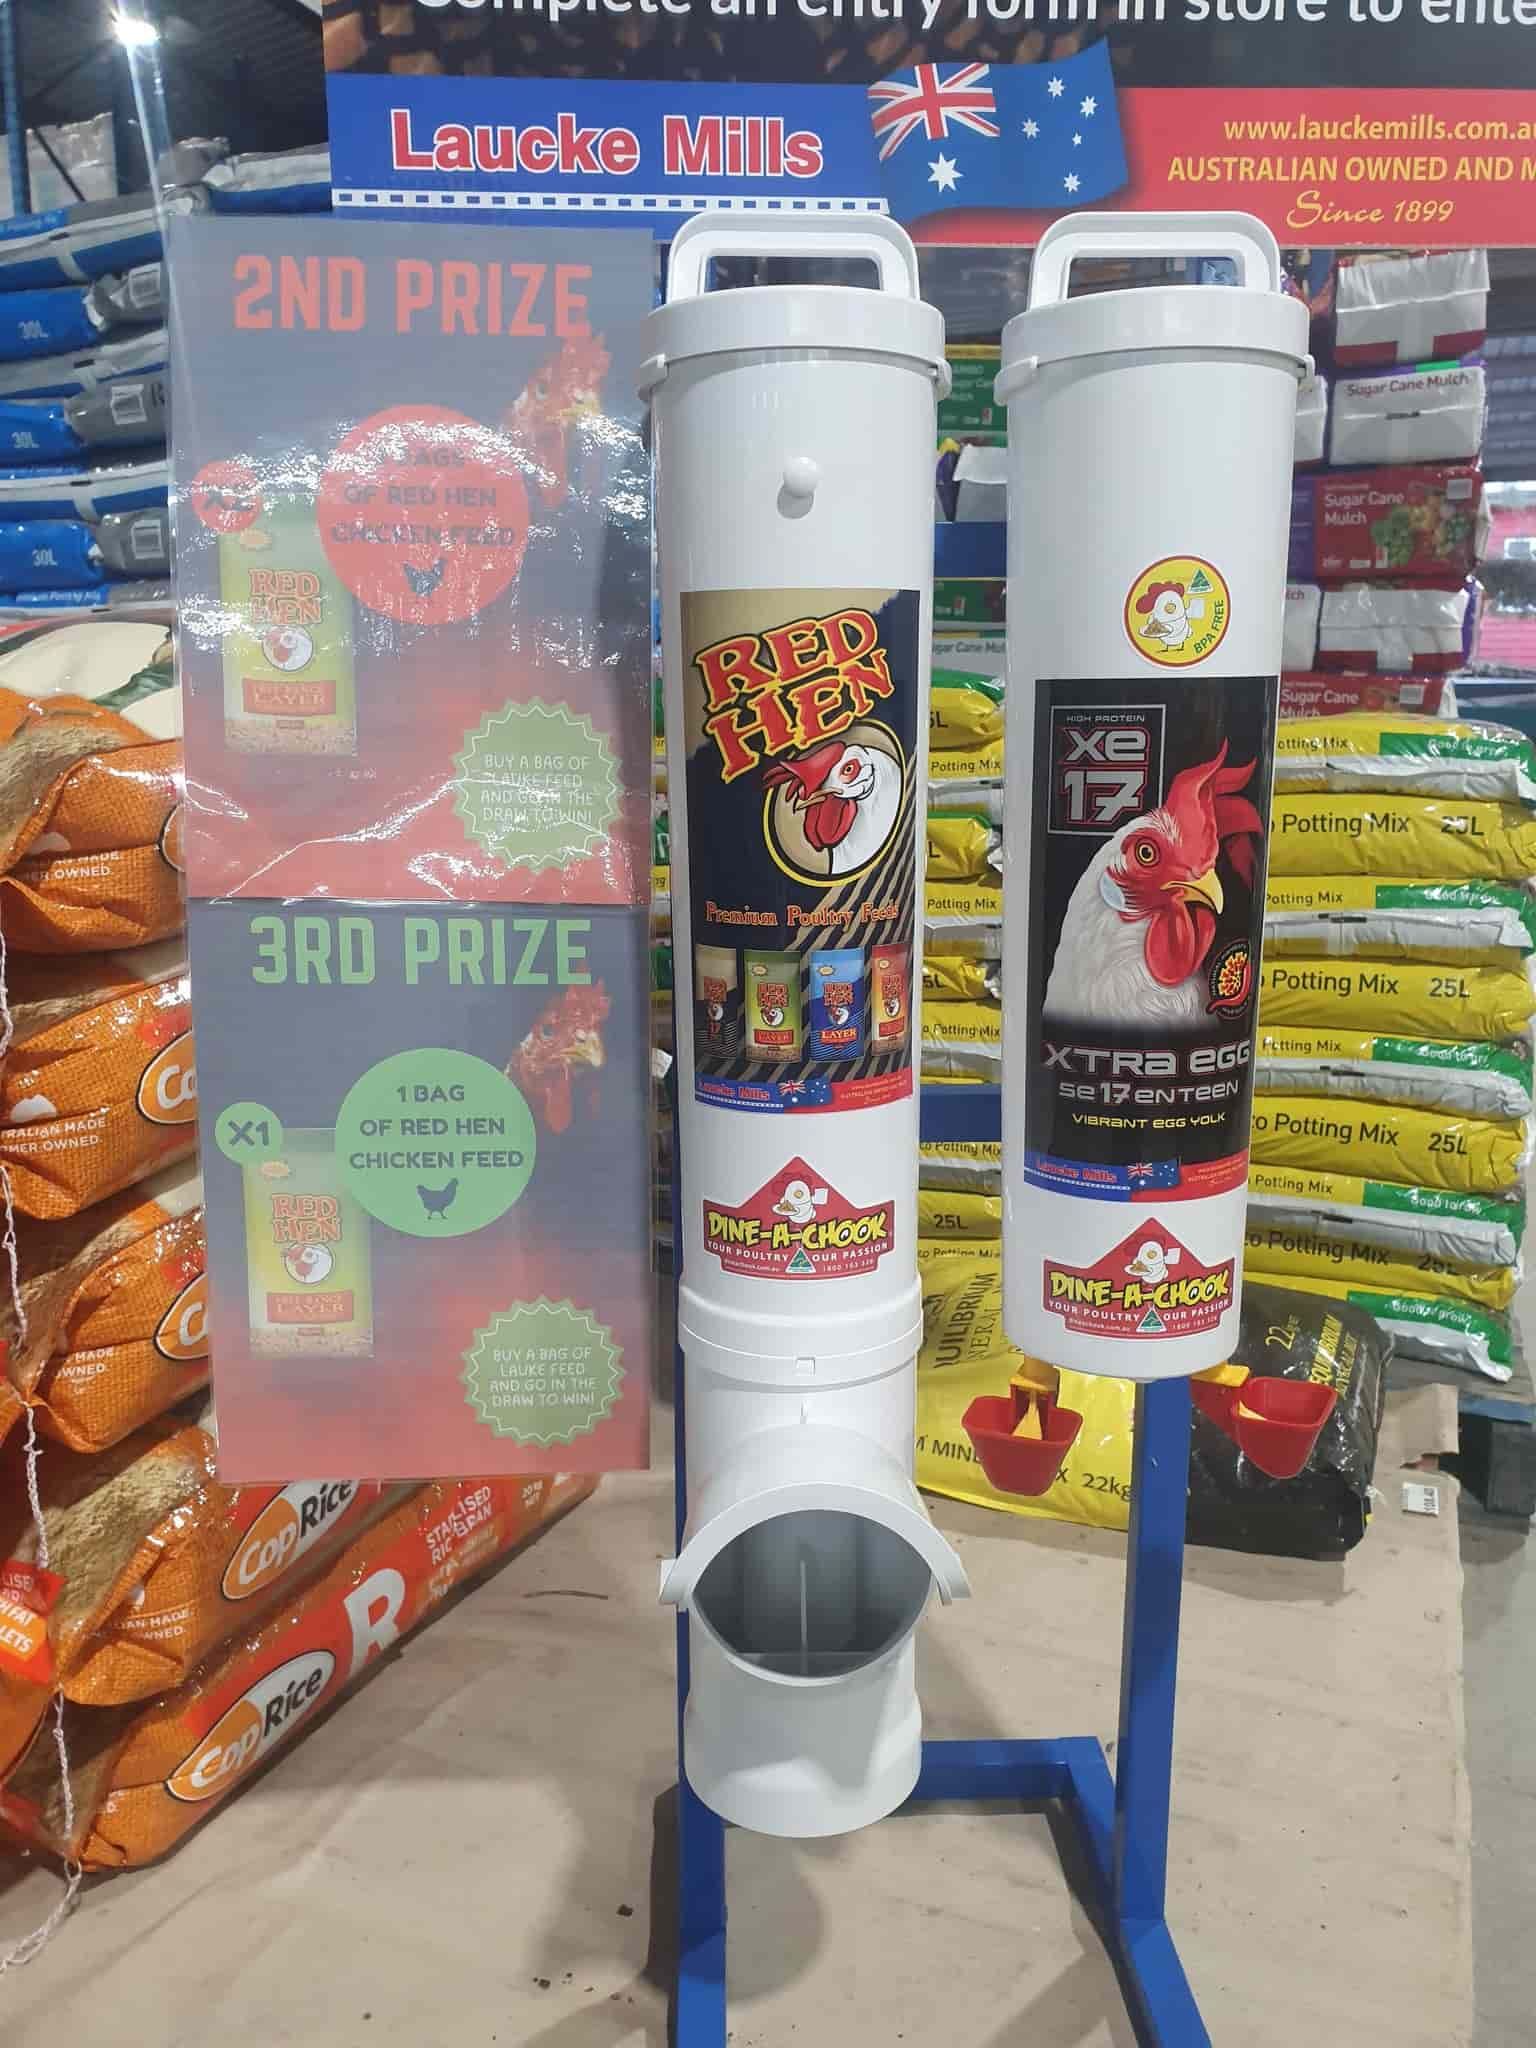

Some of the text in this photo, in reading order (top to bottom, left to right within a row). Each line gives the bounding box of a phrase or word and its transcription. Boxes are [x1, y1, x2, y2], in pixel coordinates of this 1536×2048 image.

[1223, 114, 1536, 141] www.lauckemills.com.a
[390, 109, 824, 177] Laucke Mills
[1167, 155, 1337, 182] AUSTRALIAN
[1345, 157, 1448, 182] OWNED
[1454, 156, 1514, 181] AND
[1286, 190, 1455, 229] Since 1899
[233, 255, 592, 337] 2ND PRIZE
[1346, 373, 1469, 397] Sugar Cane Mulch
[1325, 490, 1405, 511] Sugar Cane
[1325, 511, 1367, 527] Mulch
[249, 568, 321, 596] RED
[1210, 599, 1225, 633] FREE
[1193, 632, 1216, 655] BPA
[692, 608, 879, 714] RED
[1281, 688, 1360, 705] Sugar Cane
[703, 648, 896, 784] HEN
[1066, 713, 1145, 722] HIGH PROTEIN
[1277, 737, 1348, 752] otting Mix
[534, 755, 564, 769] BAG
[930, 758, 1001, 774] Potting Mix
[1063, 769, 1147, 823] 17
[1282, 812, 1363, 838] Potting
[1370, 812, 1411, 833] Mix
[927, 897, 997, 912] Potting Mix
[1318, 892, 1344, 904] Mix
[704, 900, 855, 933] Premium Poultry
[250, 916, 593, 985] 3RD PRIZE
[1272, 969, 1350, 996] Potting
[1358, 974, 1400, 996] Mix
[1429, 977, 1471, 999] 25L
[933, 1023, 1000, 1037] Potting Mix
[1262, 1037, 1342, 1054] Potting Mix
[396, 1084, 466, 1103] 1 BAG
[359, 1117, 505, 1137] OF RED HEN
[1190, 1111, 1226, 1127] YOLK
[227, 1120, 271, 1146] X1
[1275, 1112, 1353, 1145] Potting
[1359, 1121, 1399, 1147] Mix
[1427, 1132, 1468, 1155] 25L
[349, 1150, 523, 1169] CHICKEN FEED
[1255, 1174, 1334, 1194] Potting Mix
[270, 1192, 338, 1219] RED
[272, 1217, 342, 1243] HEN
[707, 1210, 888, 1250] DINE-A-CHOOK
[933, 1213, 968, 1230] 25L
[706, 1240, 888, 1263] YOUR POULTRY OUR PASSION
[1268, 1230, 1344, 1265] Potting
[1351, 1244, 1391, 1265] Mix
[1049, 1268, 1230, 1310] DINE-A-CHOOK
[933, 1272, 998, 1368] UILIBRIUM
[1049, 1300, 1229, 1322] YOUR POULTRY OUR PASSION
[493, 1346, 592, 1361] BUY A BAG OF
[551, 1362, 585, 1376] FEED
[489, 1377, 599, 1393] AND GO IN THE
[492, 1394, 535, 1408] DRAW
[537, 1392, 559, 1407] TO
[237, 1481, 352, 1585] CopRice
[431, 1537, 453, 1565] RIC
[191, 1665, 324, 1790] CopRice
